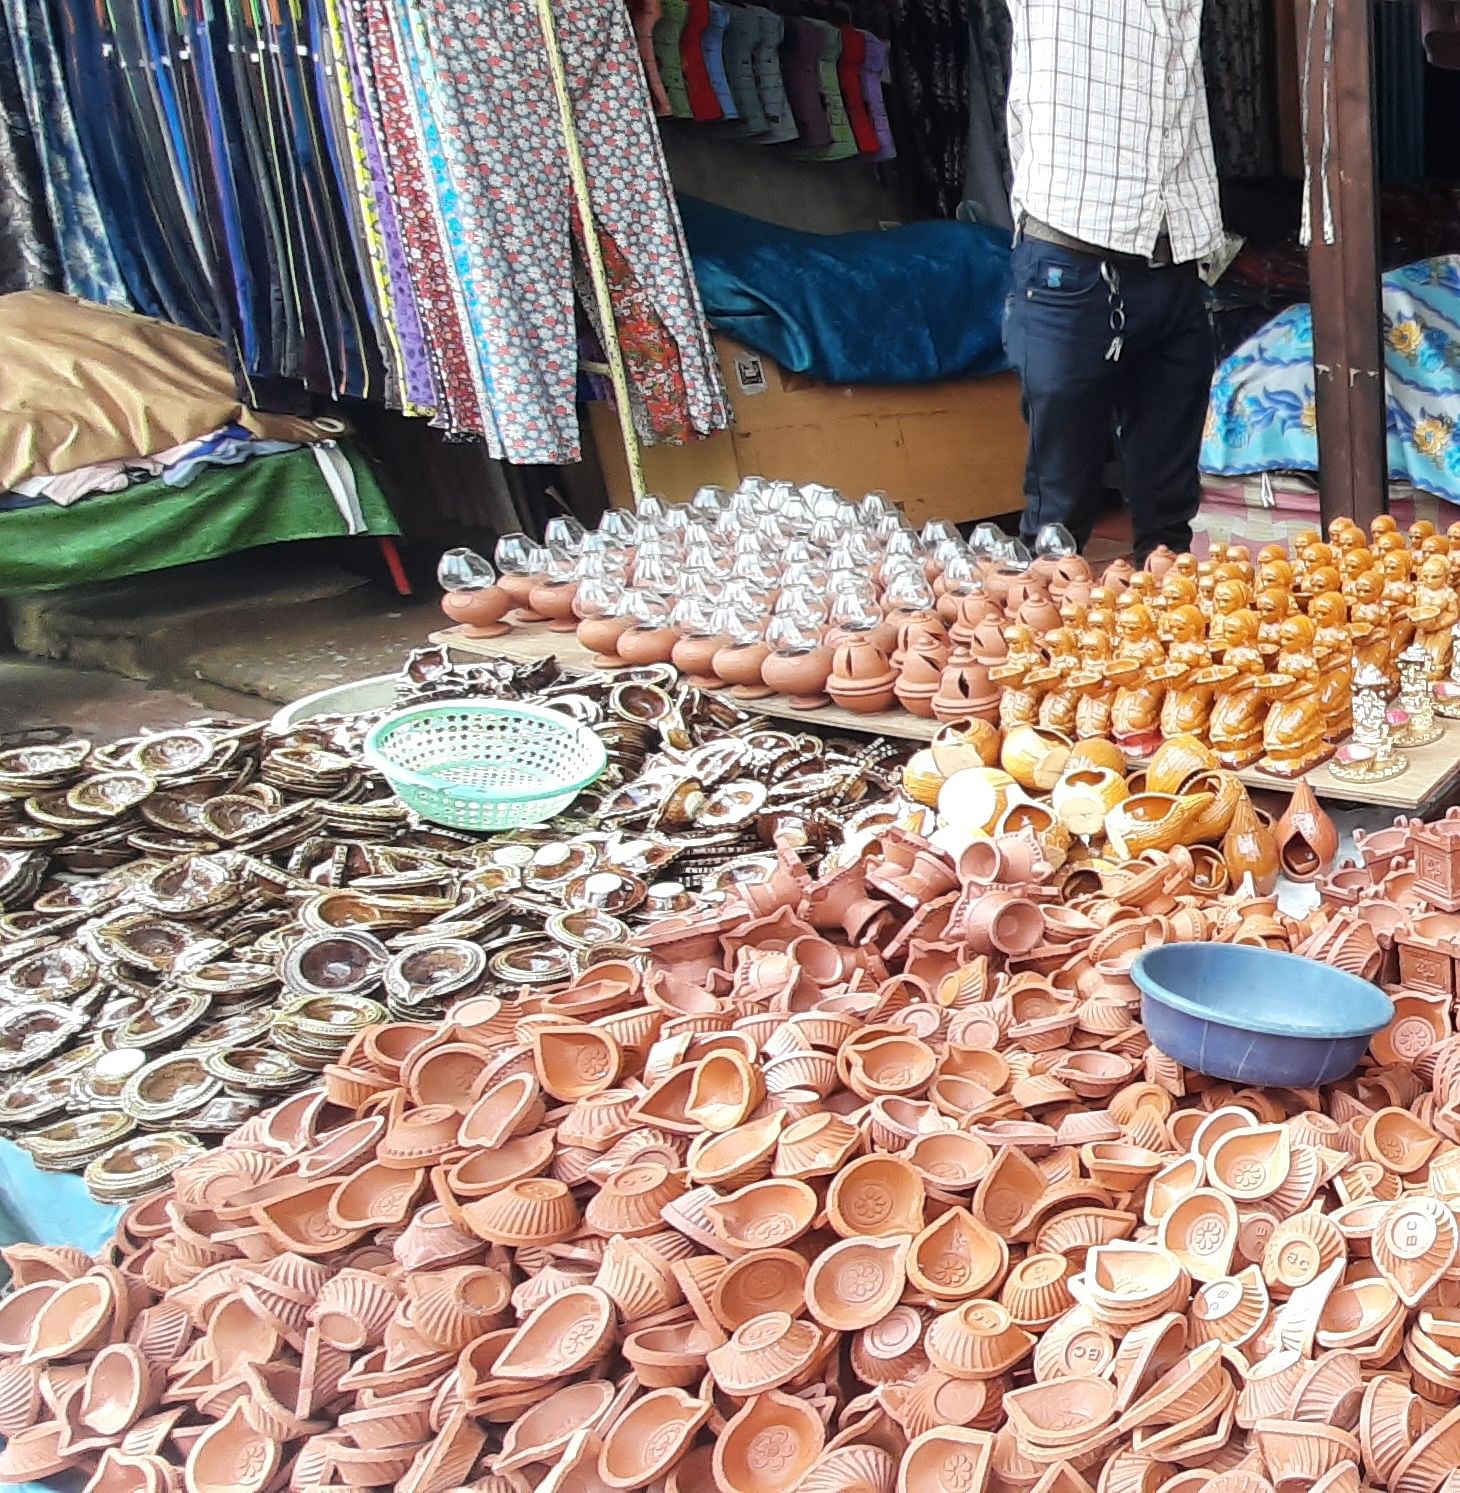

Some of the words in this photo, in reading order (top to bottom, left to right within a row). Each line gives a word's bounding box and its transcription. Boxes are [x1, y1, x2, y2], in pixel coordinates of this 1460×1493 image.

[1406, 1220, 1417, 1246] BC
[1210, 1289, 1229, 1311] BC
[1074, 1345, 1101, 1361] BC
